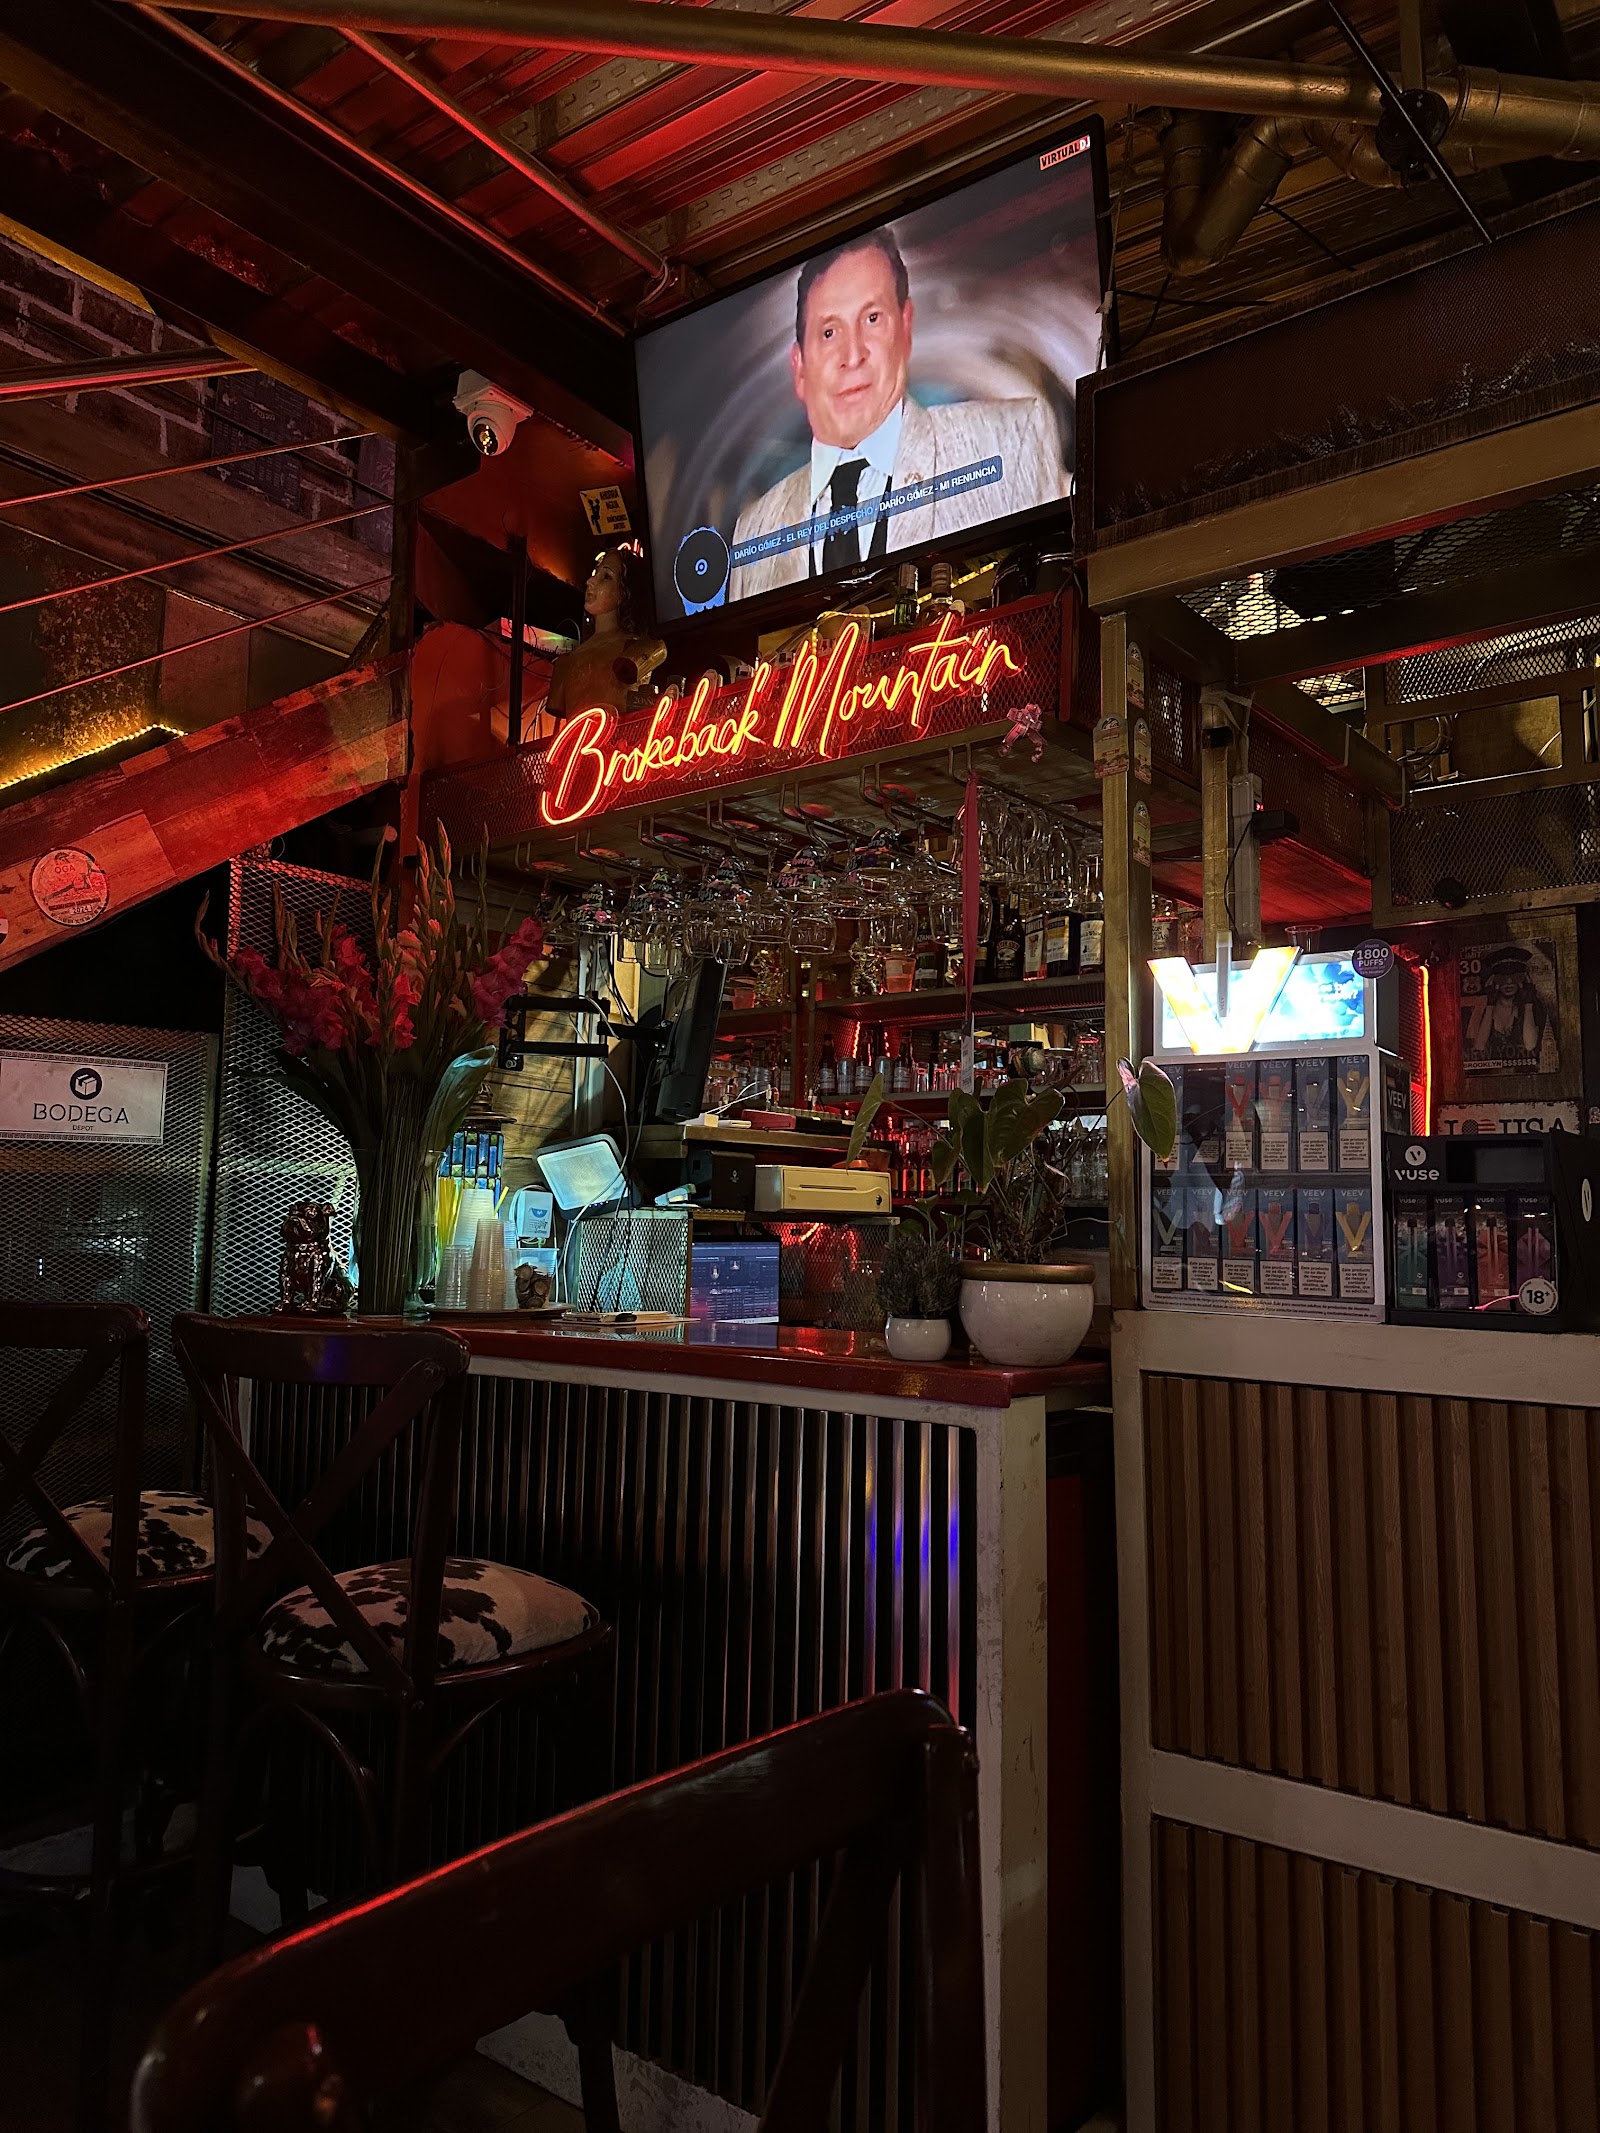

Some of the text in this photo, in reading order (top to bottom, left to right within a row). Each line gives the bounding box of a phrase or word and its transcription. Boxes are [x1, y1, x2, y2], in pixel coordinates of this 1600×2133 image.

[1041, 135, 1090, 167] VIRTUALDJ
[787, 534, 797, 543] EL
[797, 528, 812, 540] REY
[814, 523, 829, 535] DEL
[830, 507, 873, 528] DESPECHO
[879, 495, 905, 512] DARÍO
[907, 487, 934, 502] GÓMEZ
[940, 481, 949, 491] MI
[951, 465, 997, 488] RENUNCIA
[541, 661, 769, 826] Brokeback
[772, 611, 1020, 758] Mountain
[1356, 947, 1389, 960] 1800
[1459, 959, 1482, 975] 30
[1466, 982, 1478, 992] 66
[1227, 1061, 1253, 1069] VEEV
[1262, 1060, 1288, 1069] VEEV
[1299, 1059, 1327, 1067] VEEV
[1340, 1056, 1368, 1065] VEEV
[1463, 1060, 1502, 1069] BROOKLYN
[1387, 1088, 1407, 1110] VEEV
[33, 1103, 129, 1124] BODEGA
[1394, 1169, 1440, 1181] vuse
